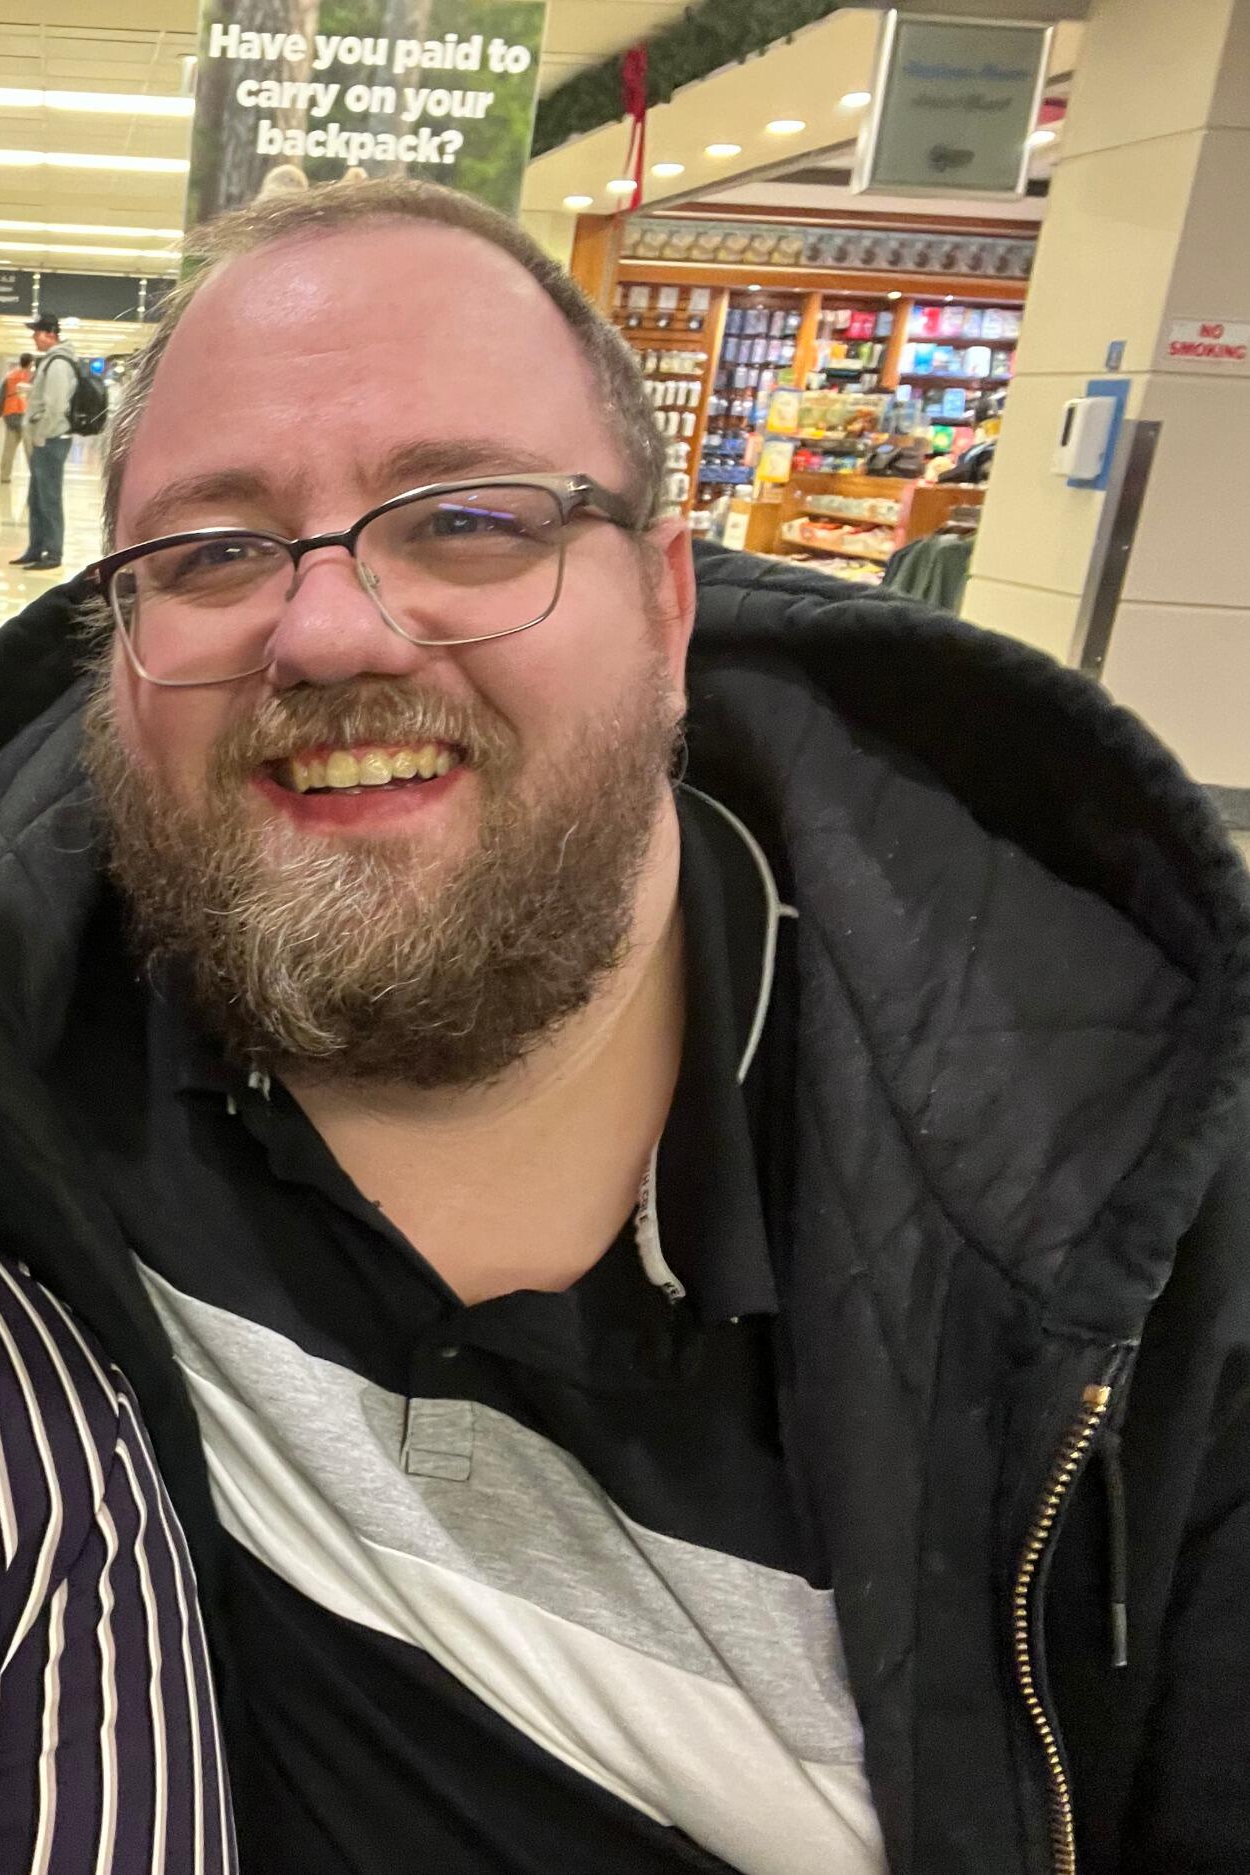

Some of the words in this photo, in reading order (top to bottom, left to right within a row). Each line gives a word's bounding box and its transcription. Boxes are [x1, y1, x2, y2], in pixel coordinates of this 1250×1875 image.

[208, 23, 307, 61] Have
[313, 35, 388, 70] you
[393, 33, 483, 73] paid
[487, 37, 531, 73] to
[236, 79, 340, 117] carry
[344, 83, 396, 114] on
[401, 87, 494, 122] your
[256, 119, 464, 165] backpack?
[1168, 341, 1247, 359] SMOKING
[1200, 323, 1224, 339] NO
